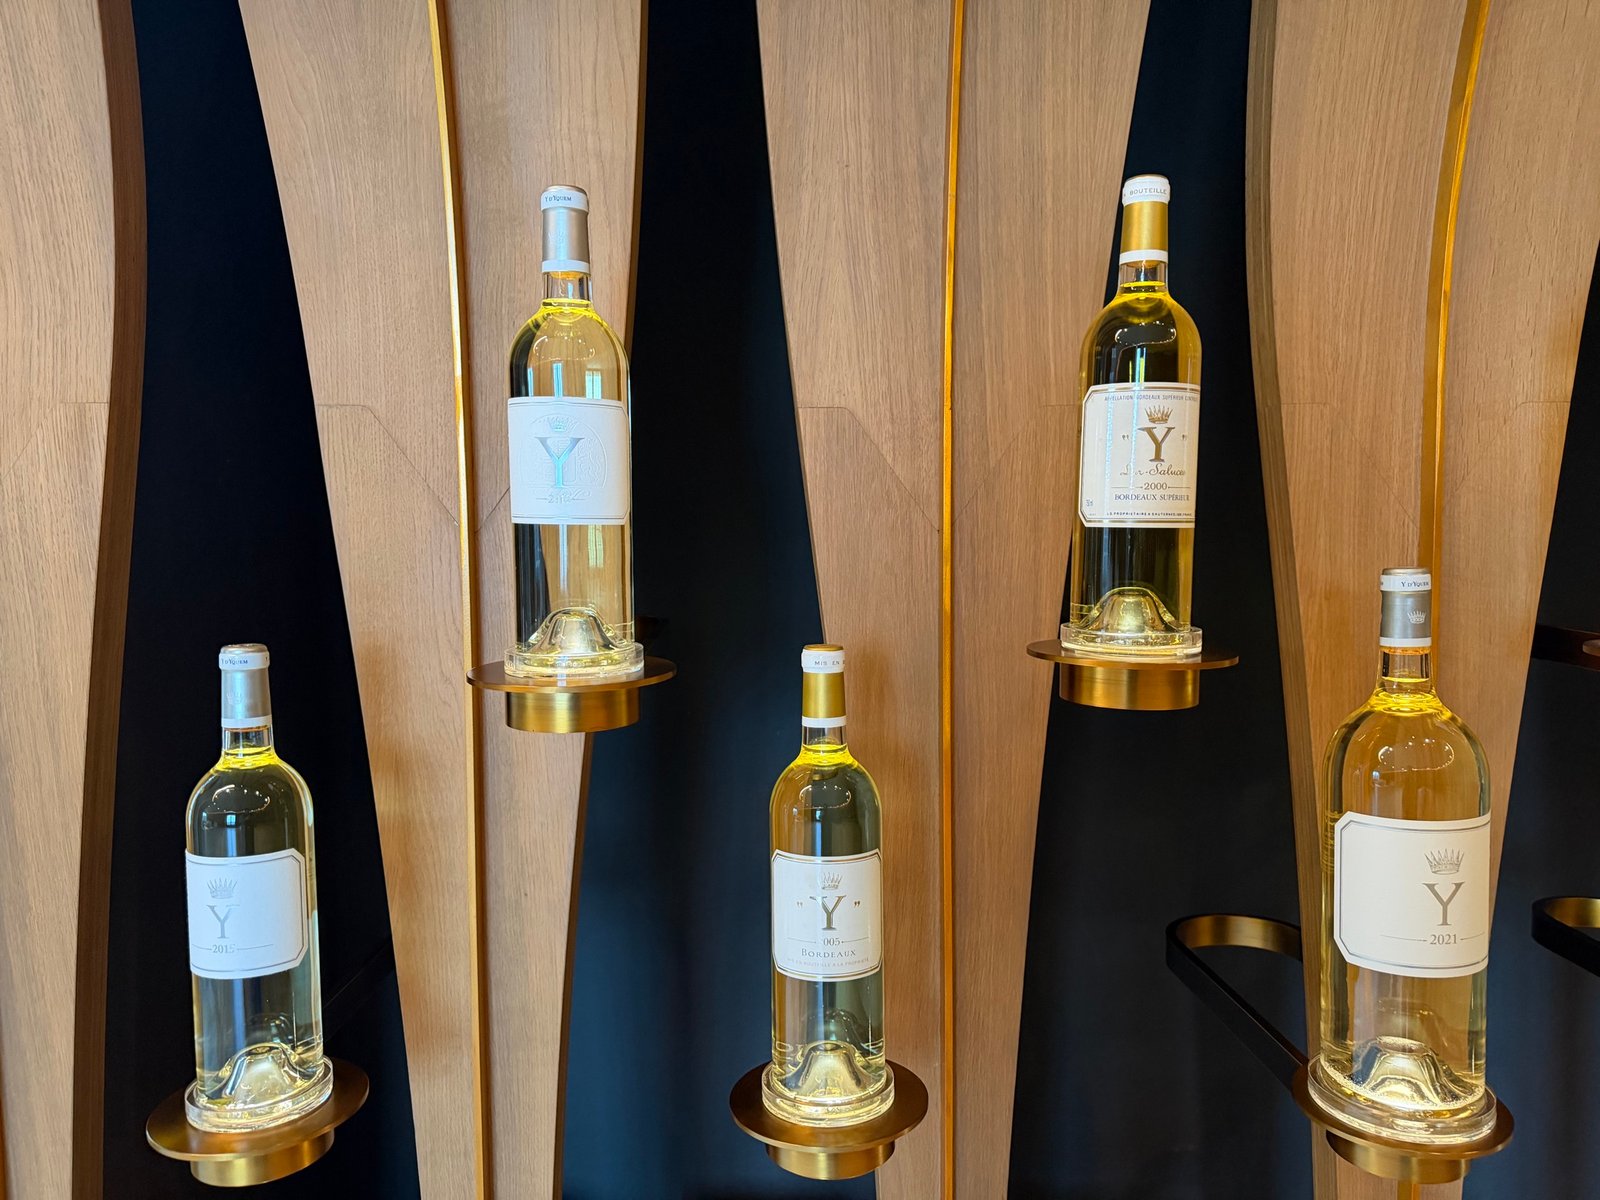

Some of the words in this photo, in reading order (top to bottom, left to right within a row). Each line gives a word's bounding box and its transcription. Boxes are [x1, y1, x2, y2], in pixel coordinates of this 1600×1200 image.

[1130, 187, 1167, 195] BOUTEILLE
[534, 436, 585, 489] Y
[1143, 482, 1168, 490] 2000
[1114, 493, 1157, 501] BORDEAUX
[1421, 881, 1466, 927] Y
[206, 904, 241, 939] Y
[1429, 933, 1458, 945] 2021
[801, 948, 857, 958] BORDEAUX
